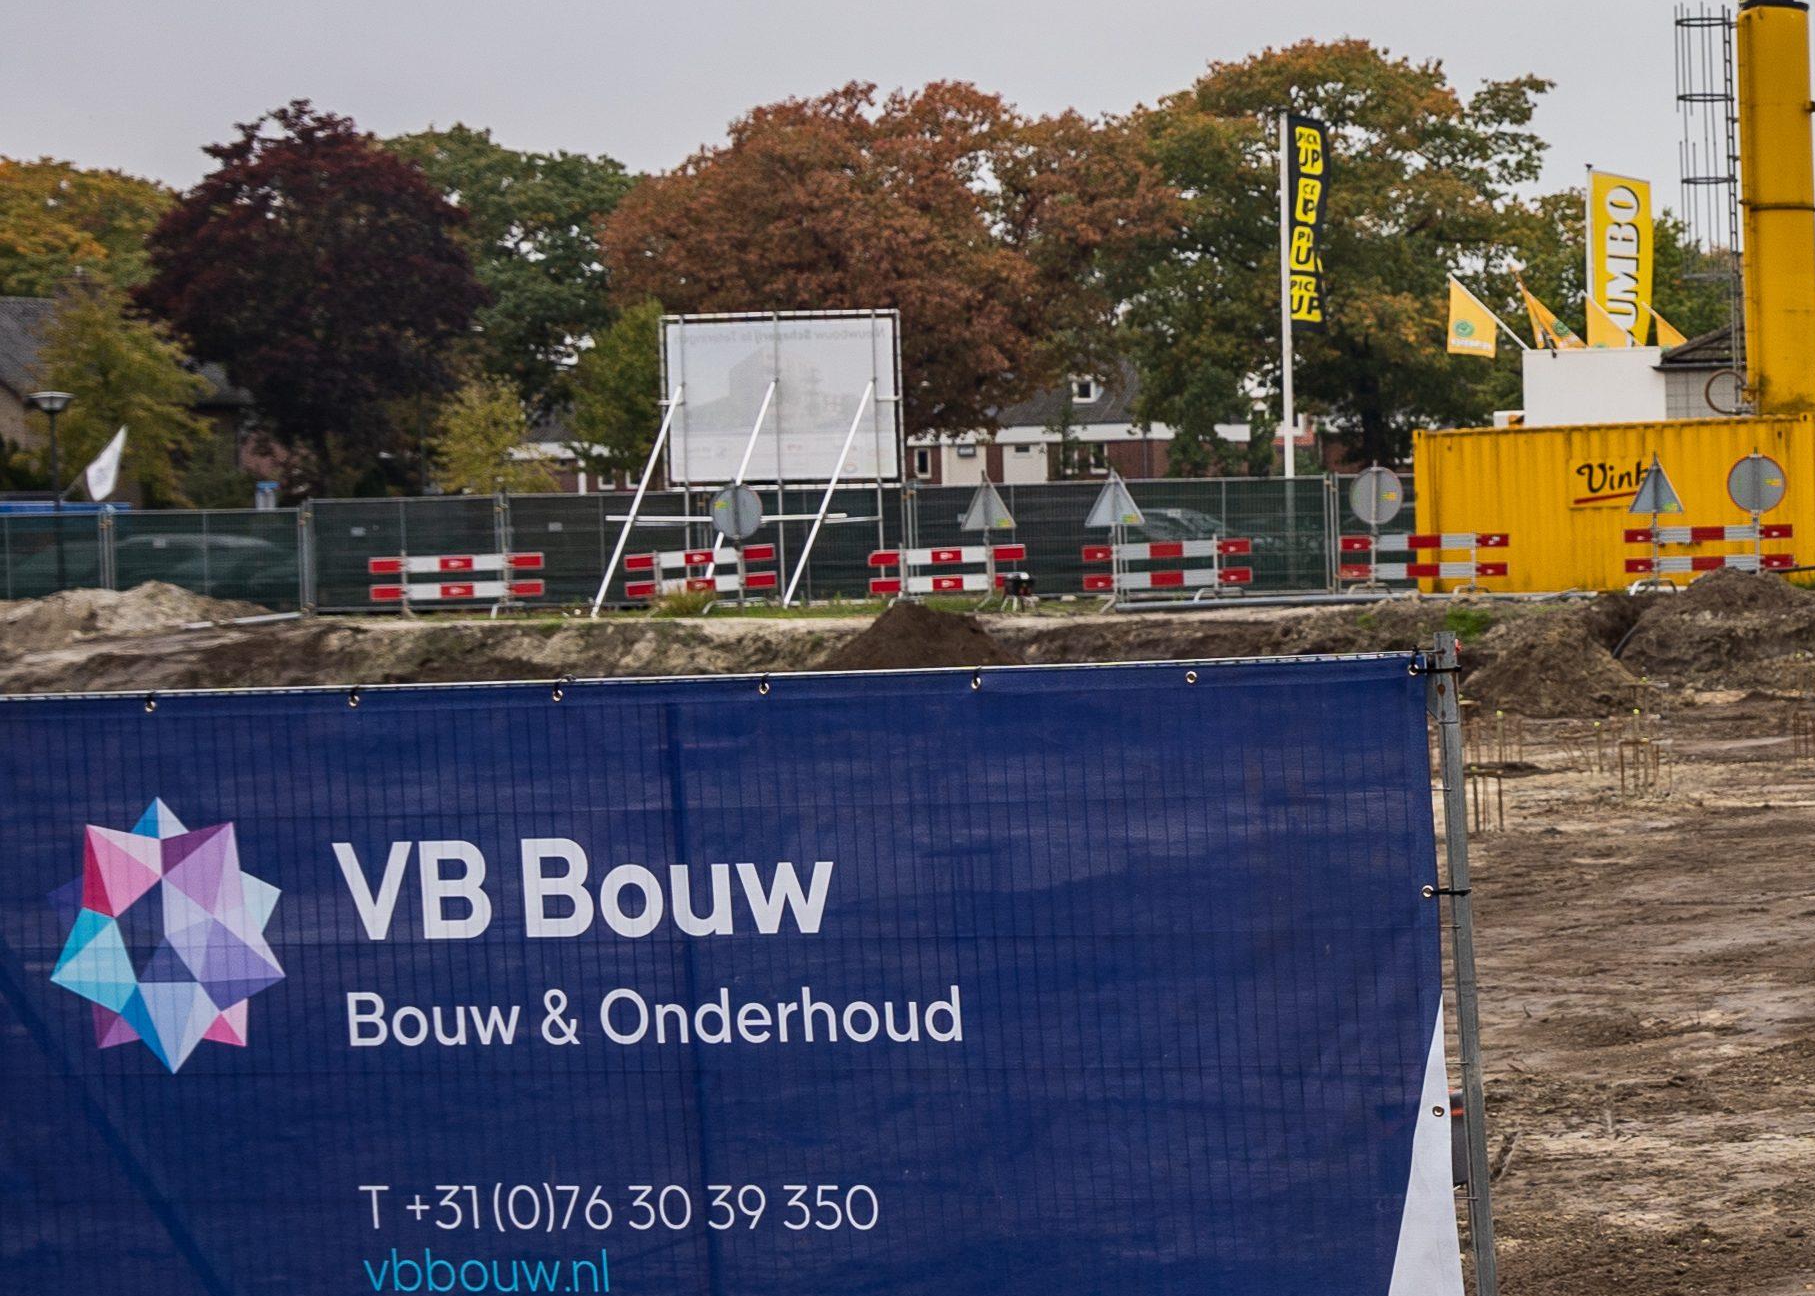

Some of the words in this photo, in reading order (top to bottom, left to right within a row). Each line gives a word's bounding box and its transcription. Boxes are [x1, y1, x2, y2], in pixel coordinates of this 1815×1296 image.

[1605, 185, 1640, 349] UMBO
[331, 840, 492, 941] VB
[520, 837, 834, 938] Bouw
[346, 991, 521, 1047] Bouw
[541, 988, 581, 1046] &
[600, 984, 963, 1045] Onderhoud
[358, 1185, 390, 1230] T
[627, 1184, 692, 1231] 30
[707, 1184, 766, 1230] 39
[782, 1184, 879, 1231] 350
[363, 1247, 610, 1293] vbbouw.nl
